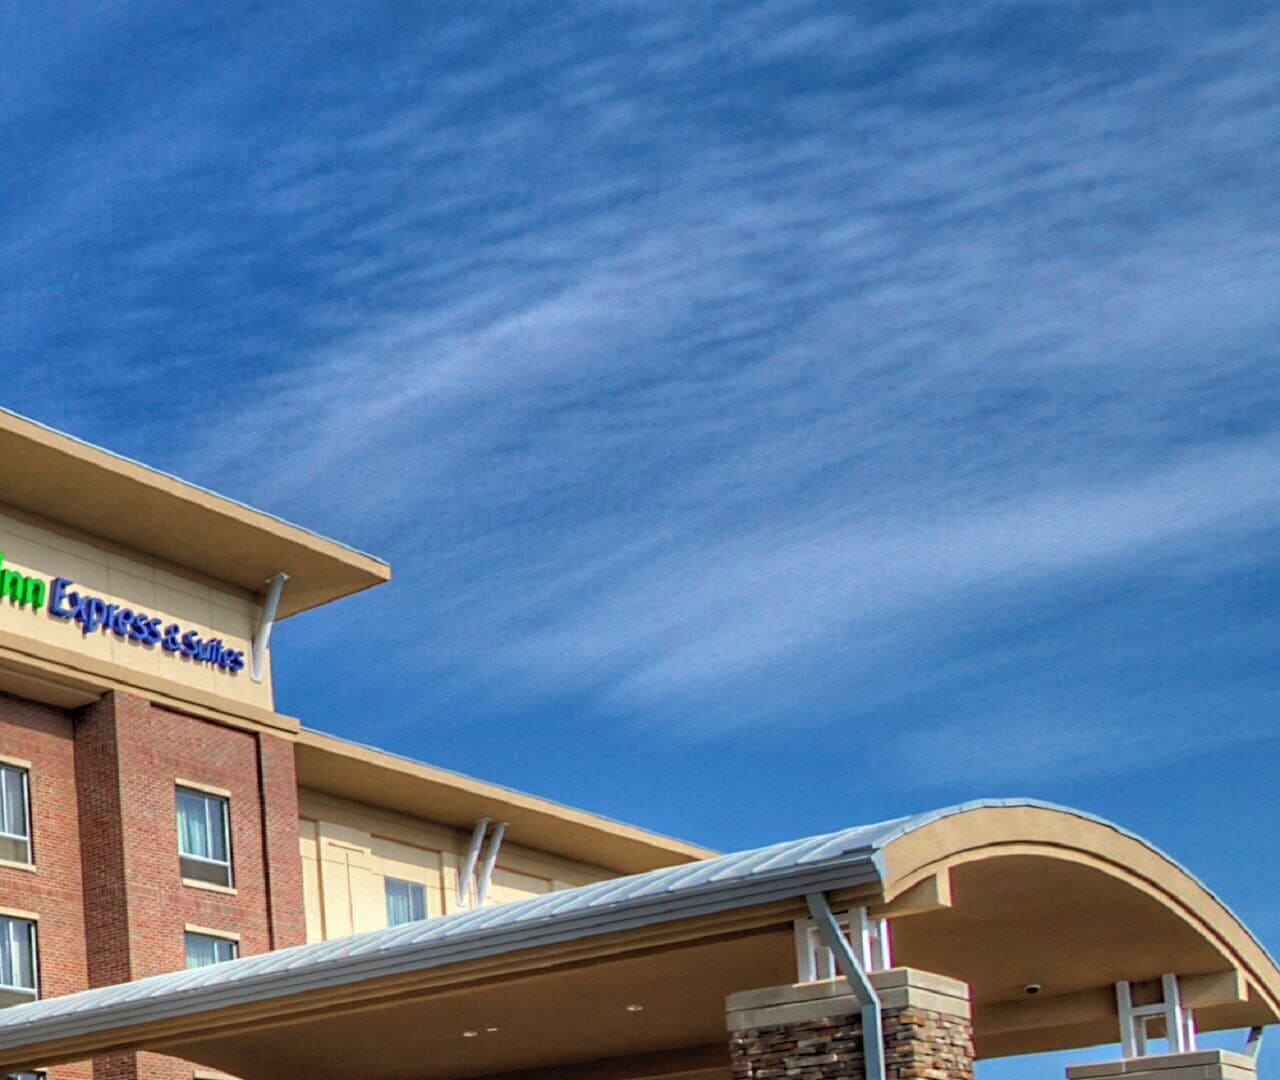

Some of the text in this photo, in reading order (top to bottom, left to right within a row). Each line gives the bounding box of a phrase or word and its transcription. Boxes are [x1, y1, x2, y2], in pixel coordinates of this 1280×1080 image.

[49, 576, 162, 645] Express
[161, 623, 182, 652] &
[181, 630, 245, 673] Suites
